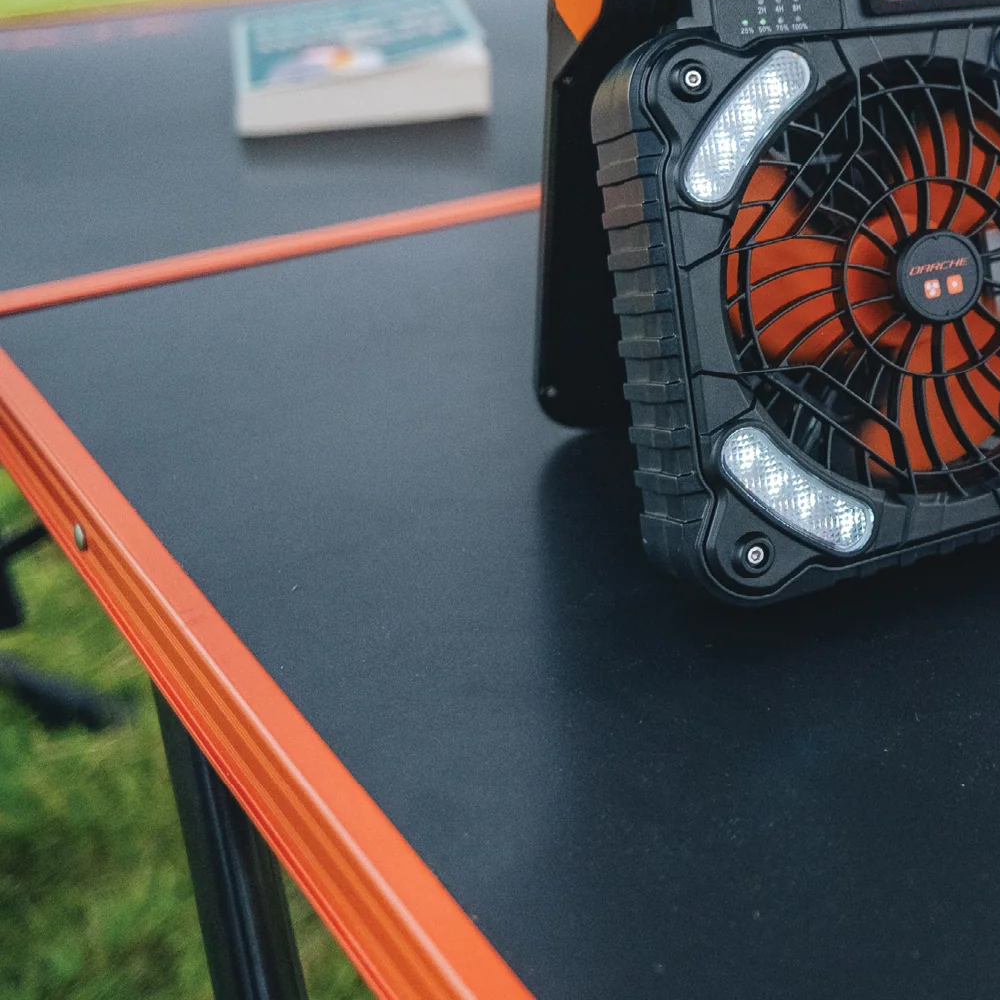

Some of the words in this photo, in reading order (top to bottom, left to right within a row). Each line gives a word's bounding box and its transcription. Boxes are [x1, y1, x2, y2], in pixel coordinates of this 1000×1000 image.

[757, 7, 767, 15] 2H
[775, 4, 784, 13] 4H
[909, 257, 969, 276] DARCHE
